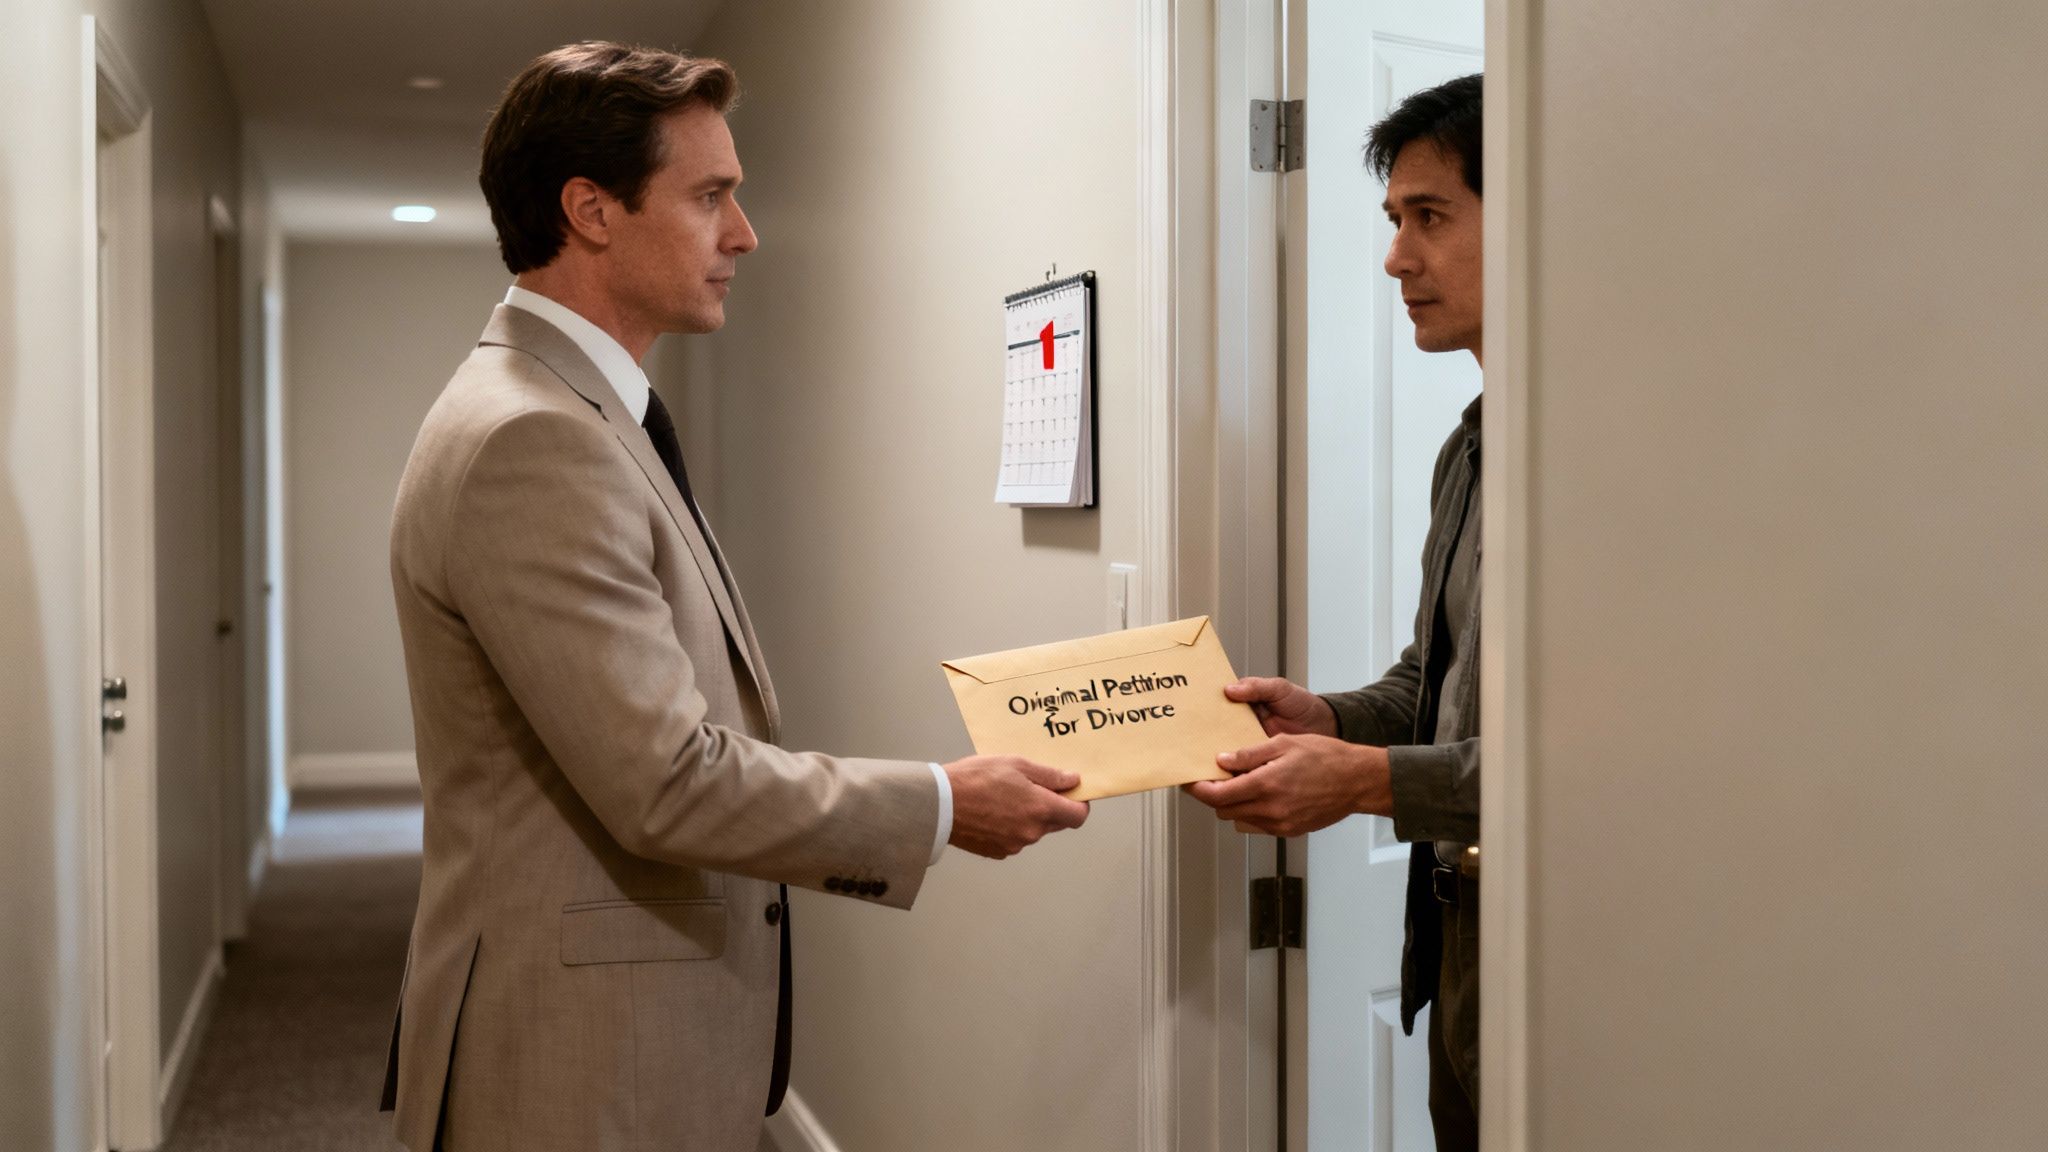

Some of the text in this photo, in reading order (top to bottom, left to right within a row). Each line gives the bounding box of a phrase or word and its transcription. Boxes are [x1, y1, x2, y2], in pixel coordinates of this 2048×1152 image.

[1039, 320, 1055, 370] 1
[1043, 704, 1175, 738] for Divorce
